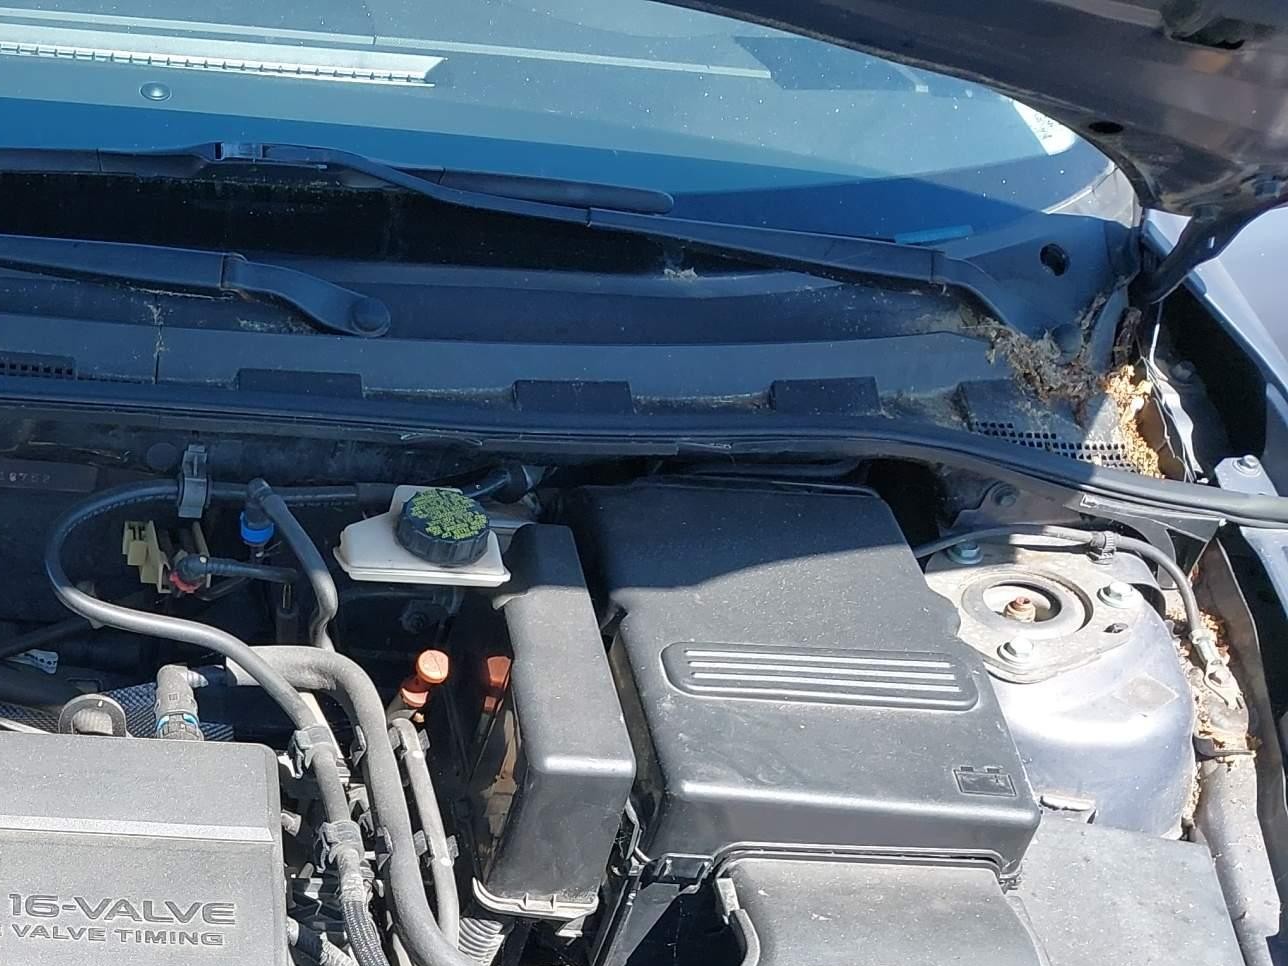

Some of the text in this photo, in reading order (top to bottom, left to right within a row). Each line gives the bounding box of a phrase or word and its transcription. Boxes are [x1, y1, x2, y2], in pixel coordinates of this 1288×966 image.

[9, 893, 236, 926] 16-VALVE
[12, 923, 106, 942] VALVE
[116, 928, 224, 946] TIMING
